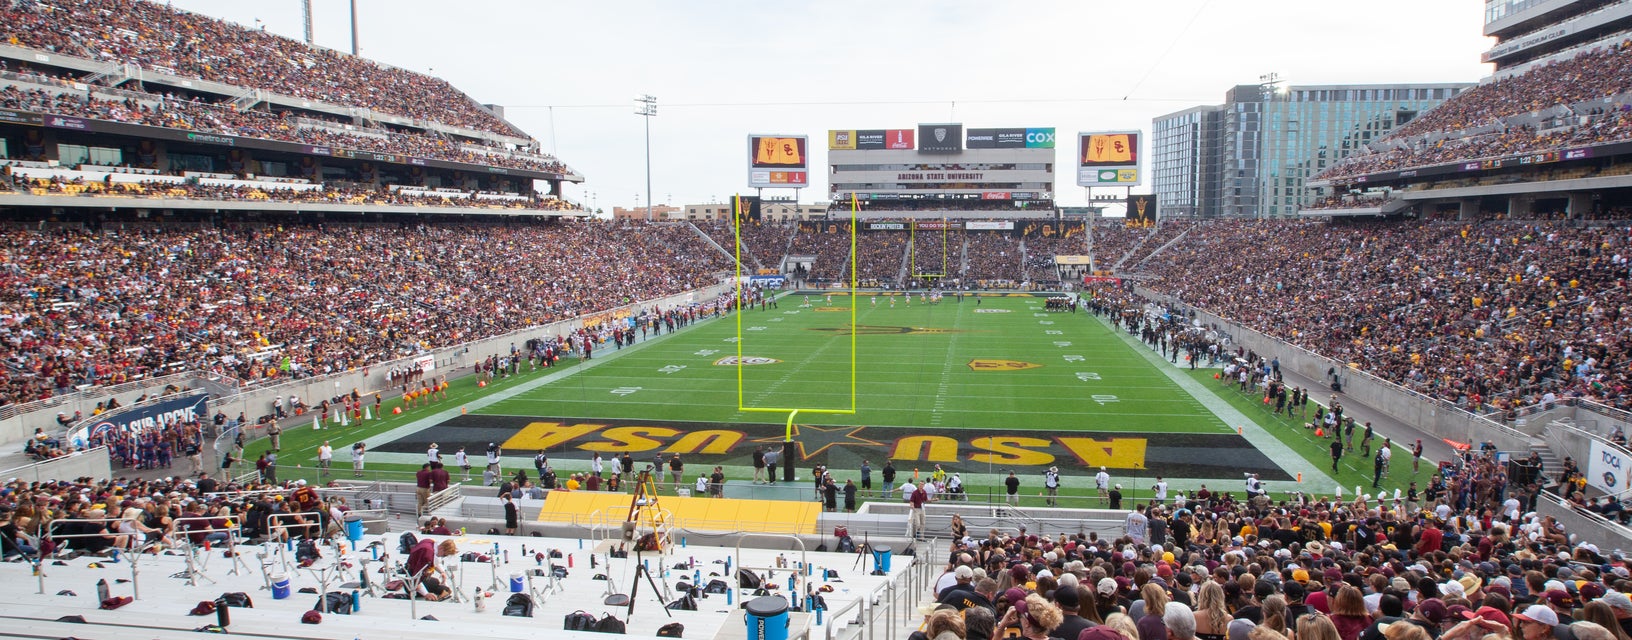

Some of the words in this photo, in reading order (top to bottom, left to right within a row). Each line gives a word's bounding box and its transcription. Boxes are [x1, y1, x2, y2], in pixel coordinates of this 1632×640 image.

[1548, 29, 1566, 40] CLUB
[1026, 132, 1055, 143] COX
[1601, 450, 1621, 470] TOCA
[1304, 528, 1317, 540] 36
